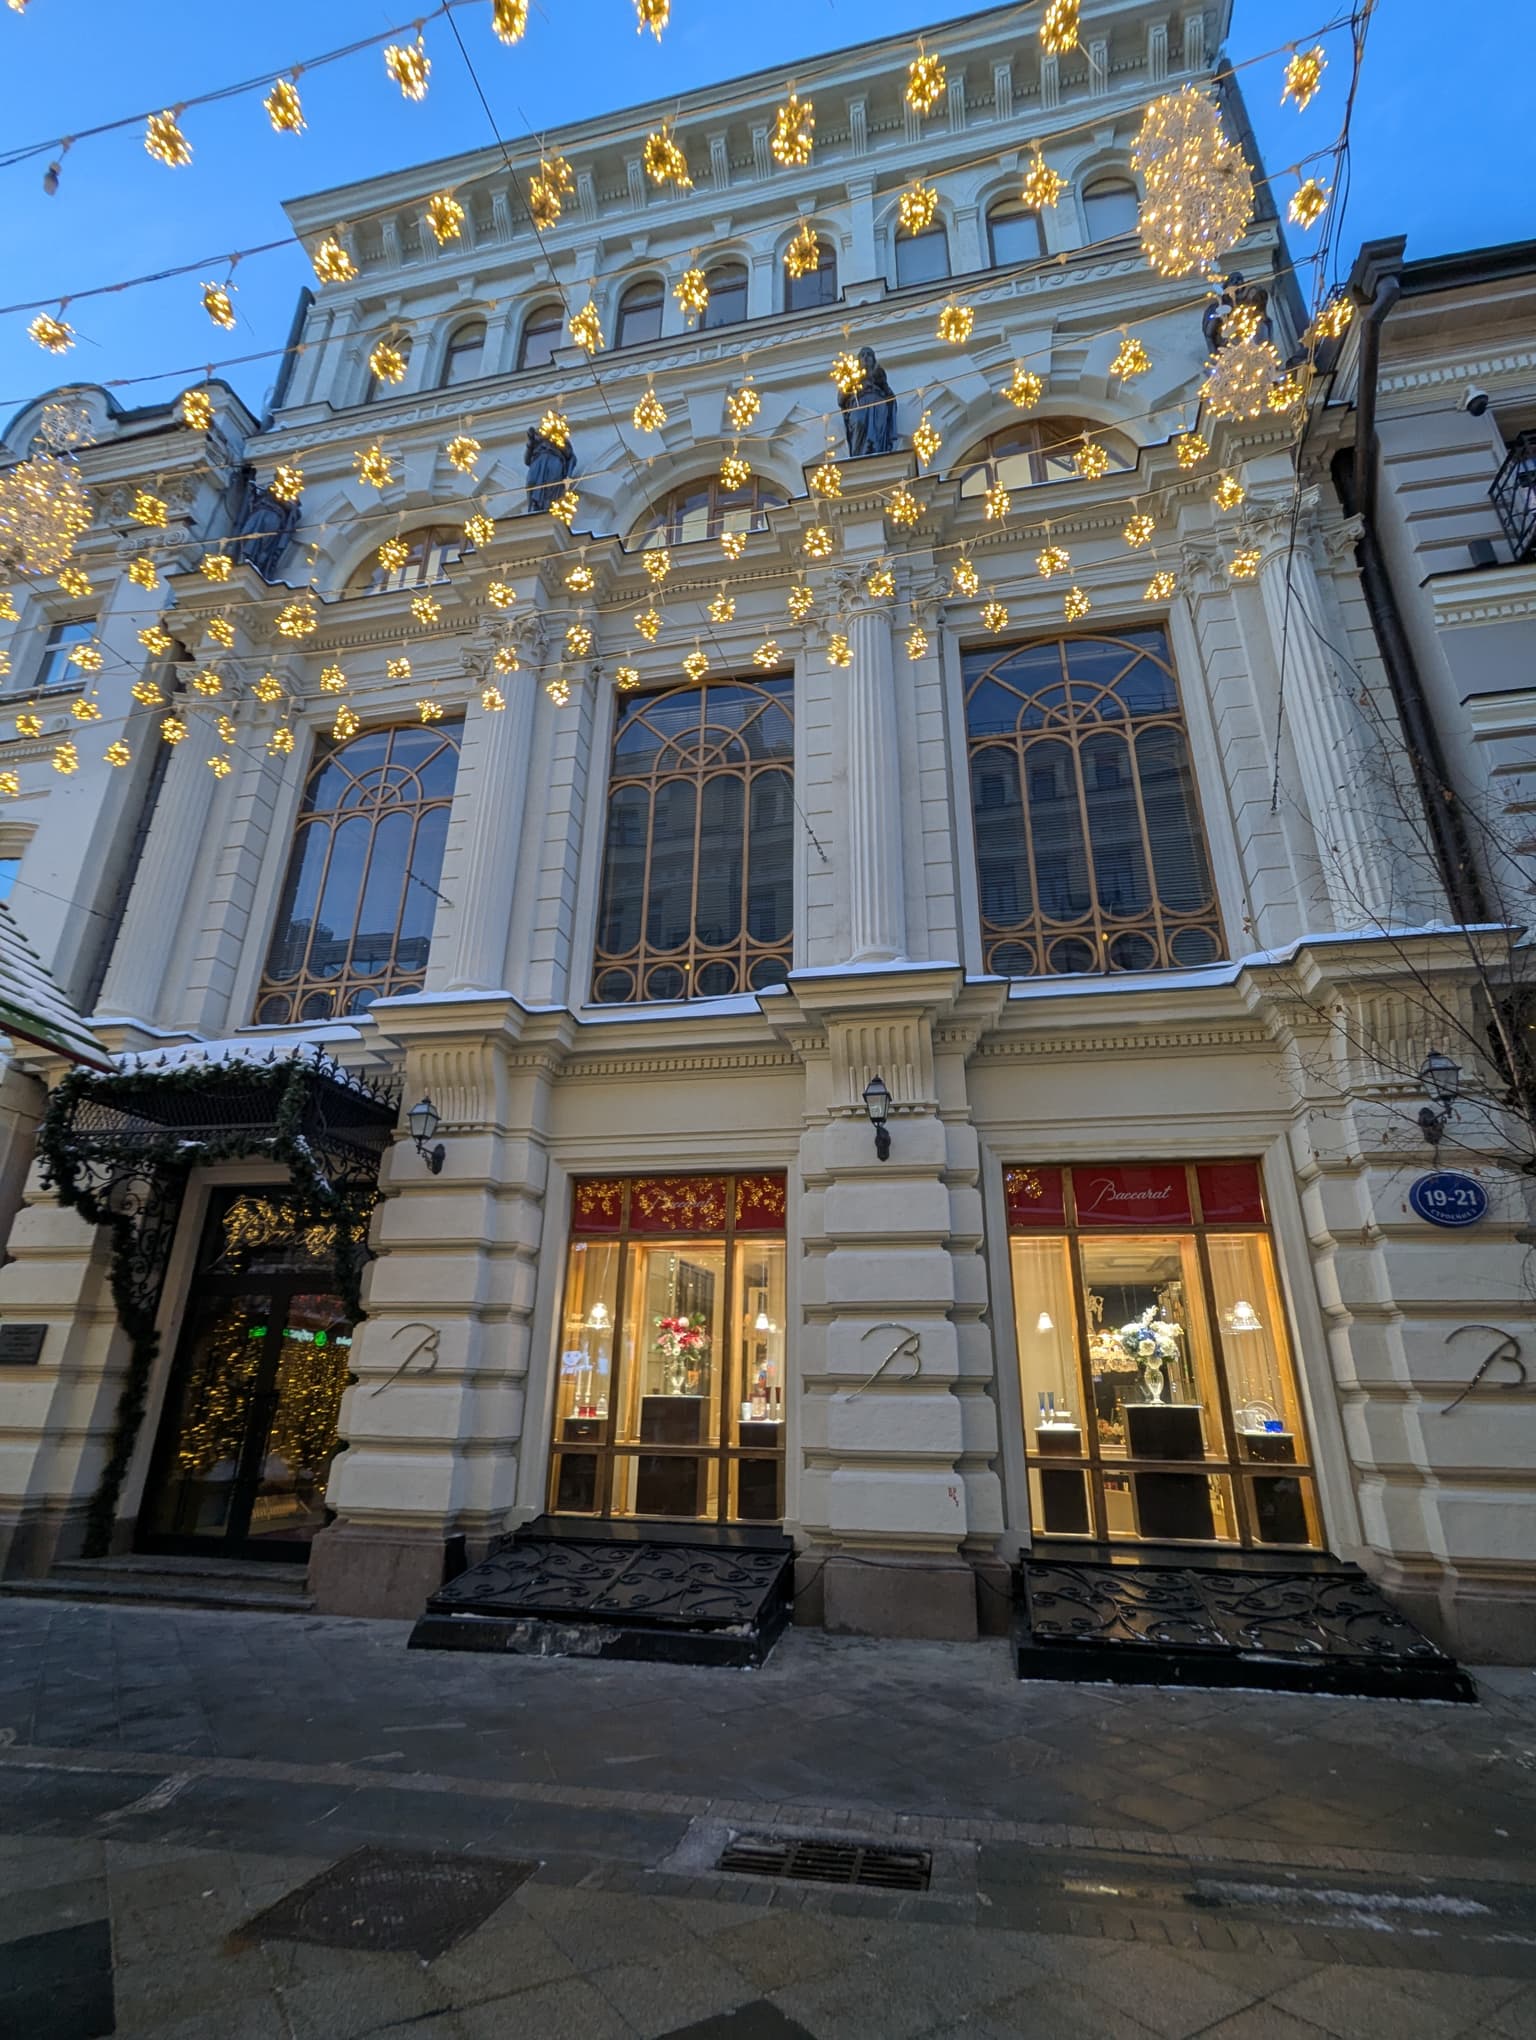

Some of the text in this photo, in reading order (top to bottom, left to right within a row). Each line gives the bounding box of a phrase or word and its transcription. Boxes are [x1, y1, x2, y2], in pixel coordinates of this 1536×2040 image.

[1088, 1178, 1172, 1212] Baccarat
[1424, 1189, 1478, 1206] 19-21
[371, 1322, 441, 1397] B
[845, 1322, 921, 1402] B
[1441, 1324, 1526, 1414] B
